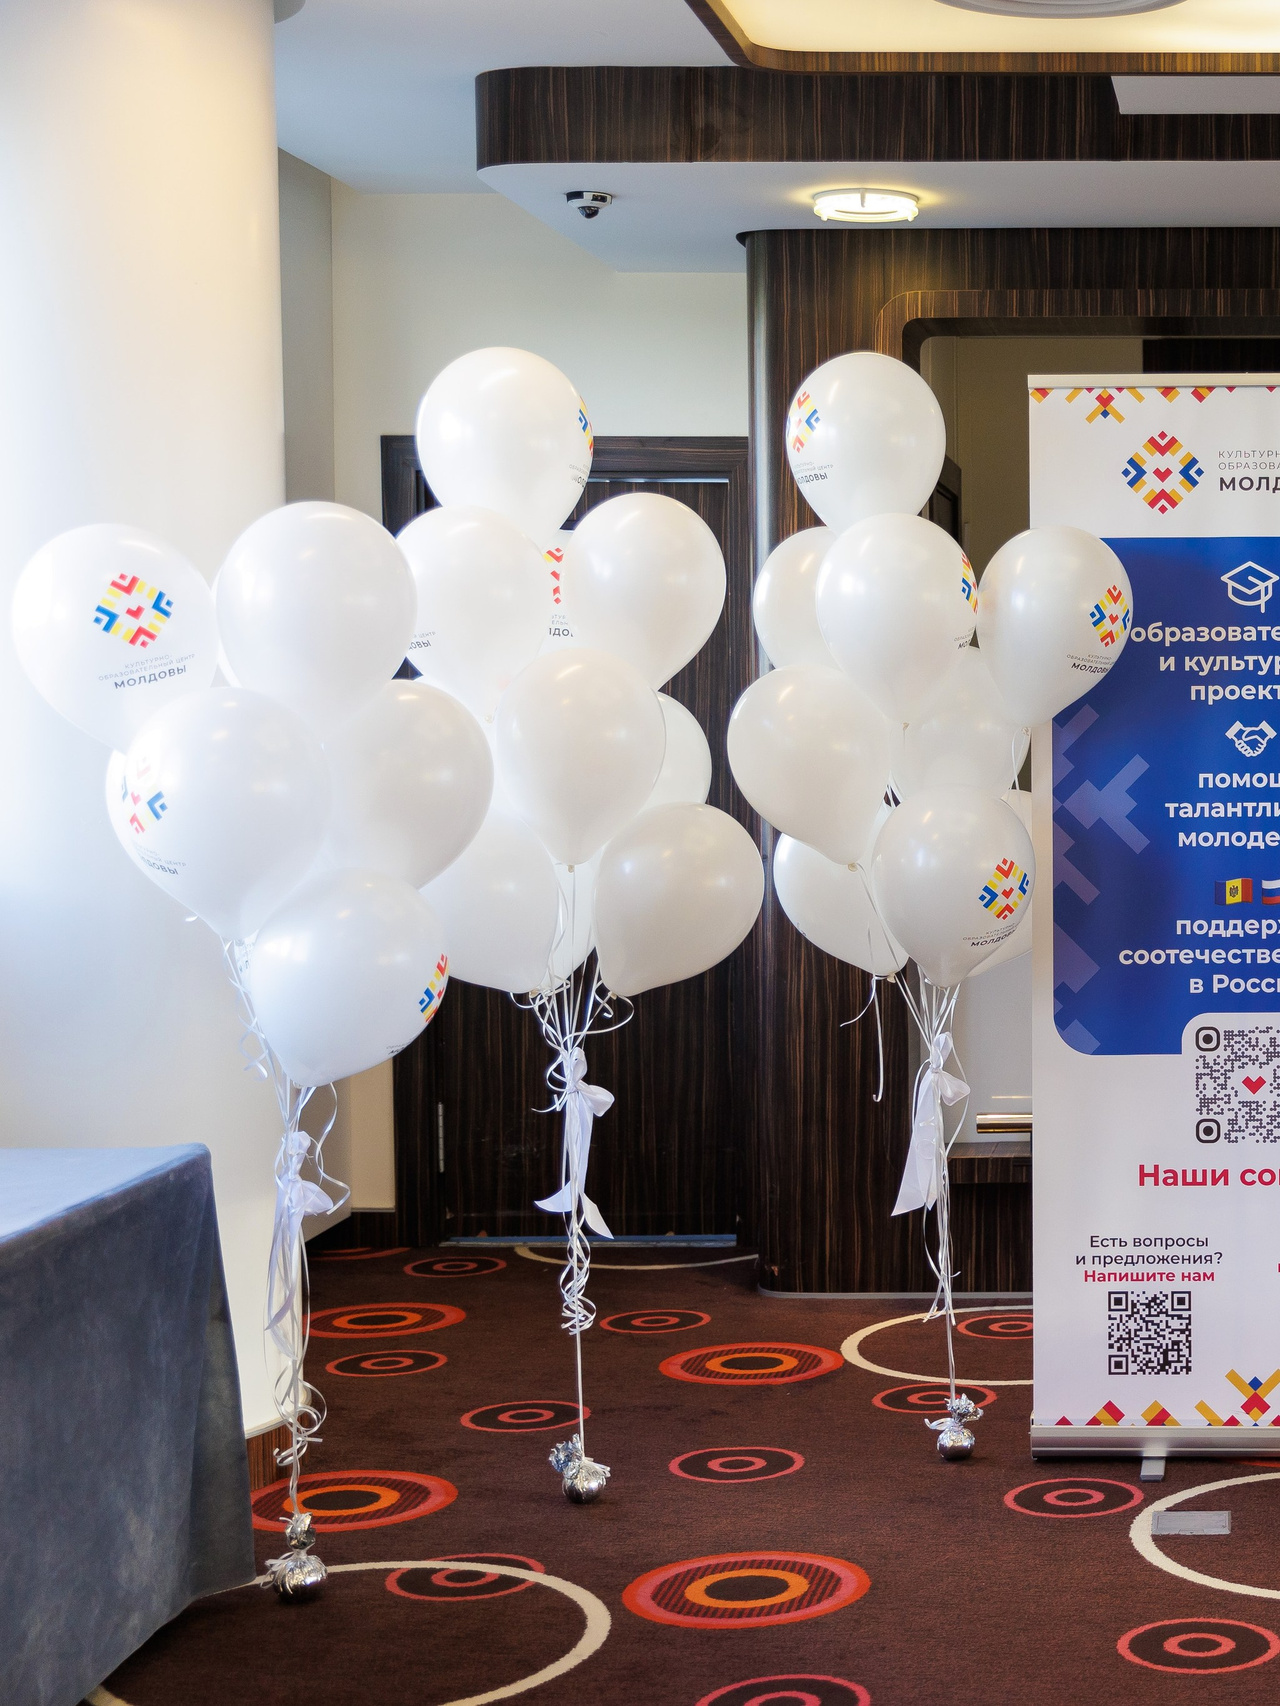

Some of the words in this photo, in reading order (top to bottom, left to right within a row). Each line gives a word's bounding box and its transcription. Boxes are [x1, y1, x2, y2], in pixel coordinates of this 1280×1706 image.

[98, 659, 174, 681] ОБРАЗОВАТЕЛЬНЫЙ
[175, 653, 195, 664] ЦЕНТР
[1159, 656, 1176, 672] и
[114, 665, 187, 689] МОЛДОВЫ
[1189, 978, 1204, 993] в
[1138, 1164, 1229, 1187] Наши
[1090, 1235, 1128, 1248] Есть
[1133, 1237, 1209, 1250] вопросы
[1075, 1255, 1086, 1266] и
[1092, 1252, 1223, 1267] предложения?
[1084, 1270, 1176, 1282] Напишите
[1181, 1271, 1215, 1282] нам
